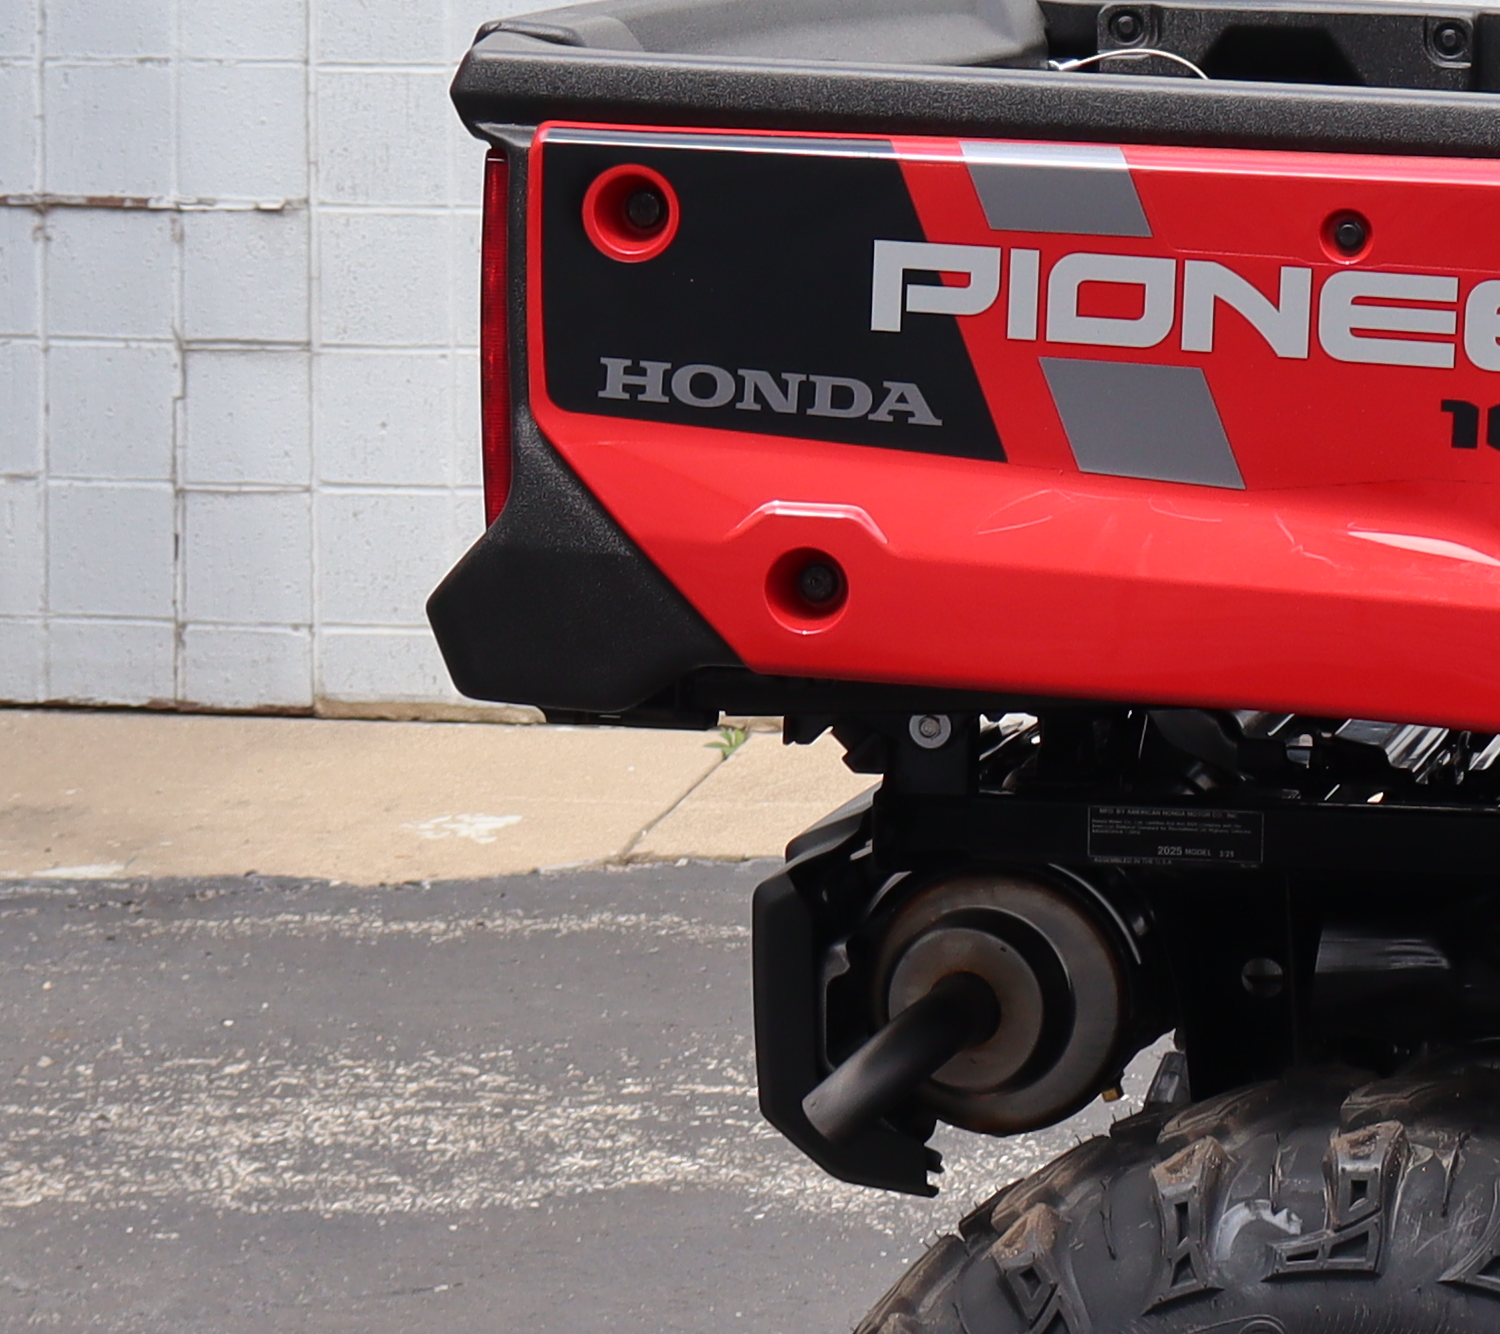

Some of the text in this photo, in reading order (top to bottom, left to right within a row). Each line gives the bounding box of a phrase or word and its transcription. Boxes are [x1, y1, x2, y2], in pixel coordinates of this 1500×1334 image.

[598, 357, 943, 427] HONDA
[1157, 845, 1183, 855] 2025
[1184, 848, 1211, 857] MODEL
